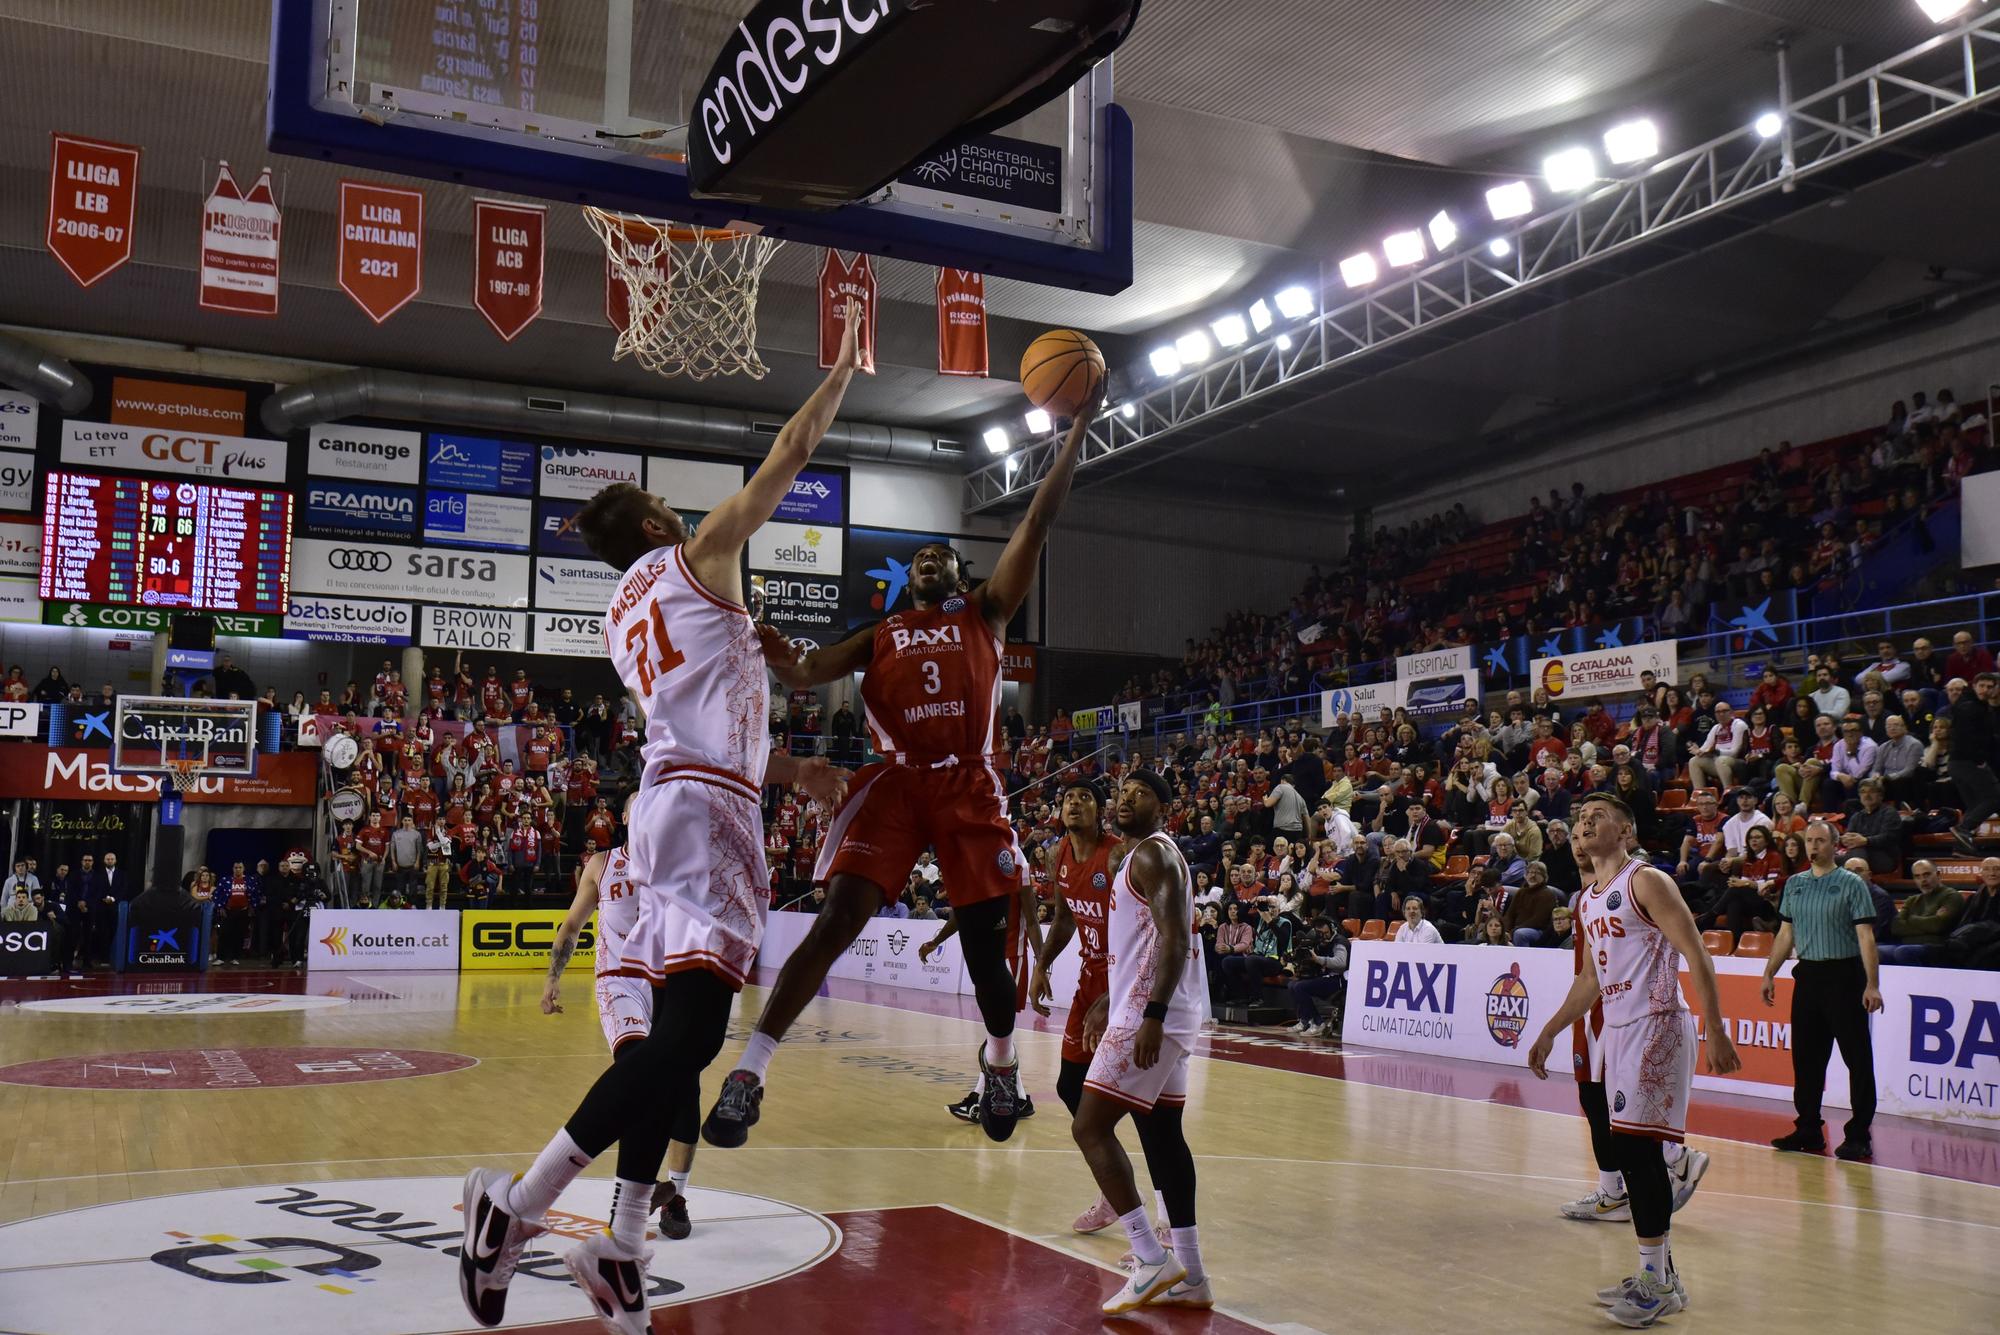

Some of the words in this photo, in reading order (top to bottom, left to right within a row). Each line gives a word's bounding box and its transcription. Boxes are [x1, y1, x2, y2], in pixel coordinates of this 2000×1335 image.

[961, 144, 1044, 170] BASKETBALL
[67, 160, 120, 187] LLIGA
[961, 157, 1055, 186] CHAMPIONS
[961, 171, 1012, 190] LEAGUE
[75, 191, 109, 213] LEB
[361, 204, 402, 225] LLIGA
[57, 217, 124, 243] 2006-07
[213, 227, 271, 241] MANRESA
[345, 224, 417, 249] CATALANA
[491, 226, 529, 247] LLIGA
[360, 257, 399, 278] 2021
[496, 249, 524, 270] ACB
[857, 266, 865, 280] 7
[488, 279, 531, 297] 1997-98
[838, 281, 870, 301] CREUS
[949, 311, 981, 321] RICOH
[116, 399, 244, 421] www.gctplus.com
[74, 430, 92, 441] La
[97, 429, 128, 441] teva
[142, 434, 220, 465] GCT
[222, 451, 265, 476] plus
[90, 446, 117, 458] ETT
[319, 438, 410, 460] canonge
[195, 465, 213, 475] ETT
[335, 457, 387, 471] Restaurant
[545, 463, 637, 482] GRUPCARULLA
[178, 506, 193, 517] RYT
[428, 496, 464, 515] arfe
[59, 516, 75, 527] Dani
[152, 515, 167, 534] 78
[177, 518, 193, 536] 66
[774, 545, 818, 564] selba
[407, 553, 497, 582] sarsa
[54, 588, 70, 599] Dani
[450, 589, 460, 598] de
[764, 579, 839, 601] BINGO
[98, 608, 161, 627] COTS
[289, 600, 407, 625] b2b.studio
[433, 609, 512, 632] BROWN
[770, 608, 832, 624] mini-casino
[290, 618, 326, 632] Marketing
[331, 623, 382, 635] Transformació
[382, 626, 406, 637] Digital
[545, 617, 604, 635] JOYS
[308, 632, 387, 646] www.b2b.studio
[433, 629, 511, 650] TAILOR
[891, 624, 962, 651] BAXI
[625, 597, 687, 698] 21
[895, 643, 963, 659] CLIMATIZACIÓN
[1570, 656, 1634, 673] CATALANA
[921, 660, 942, 695] 3
[1571, 673, 1585, 684] DE
[1588, 667, 1634, 682] TREBALL
[1354, 689, 1376, 702] Salut
[904, 700, 966, 724] MANRESA
[1354, 703, 1386, 716] Manresa
[122, 713, 259, 746] CaixaBank
[1066, 898, 1104, 918] BAXI
[352, 932, 450, 951] Kouten.cat
[138, 953, 186, 966] CaixaBank
[500, 949, 531, 958] CATALÀ
[1364, 959, 1457, 1015] BAXI
[1486, 994, 1529, 1019] BAXI
[1361, 1013, 1453, 1041] CLIMATIZACIÓN
[1493, 1018, 1521, 1036] MANRESA
